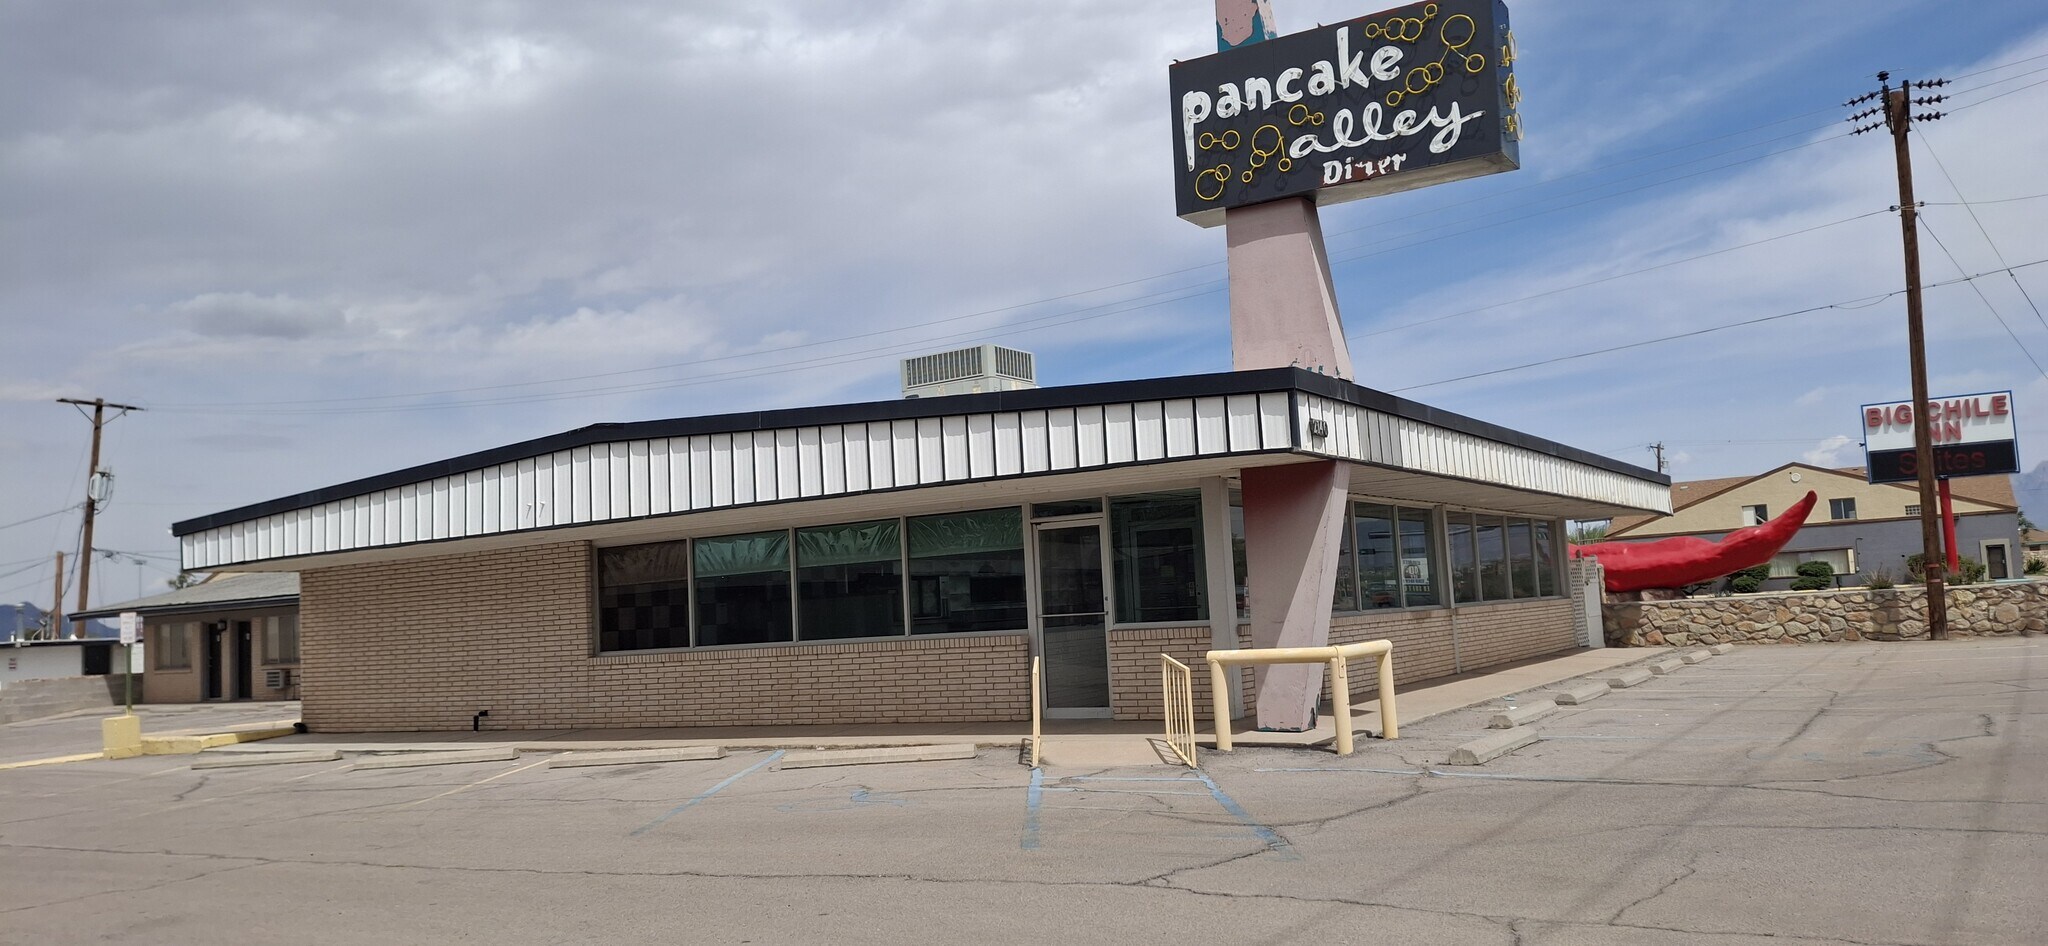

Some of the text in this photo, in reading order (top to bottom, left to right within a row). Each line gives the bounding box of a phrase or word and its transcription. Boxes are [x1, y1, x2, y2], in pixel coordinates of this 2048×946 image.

[1182, 26, 1404, 172] pancake
[1289, 101, 1487, 159] alley
[1865, 394, 2009, 428] BIG CHILE
[1925, 421, 1963, 443] NN
[1898, 451, 1987, 476] Sites
